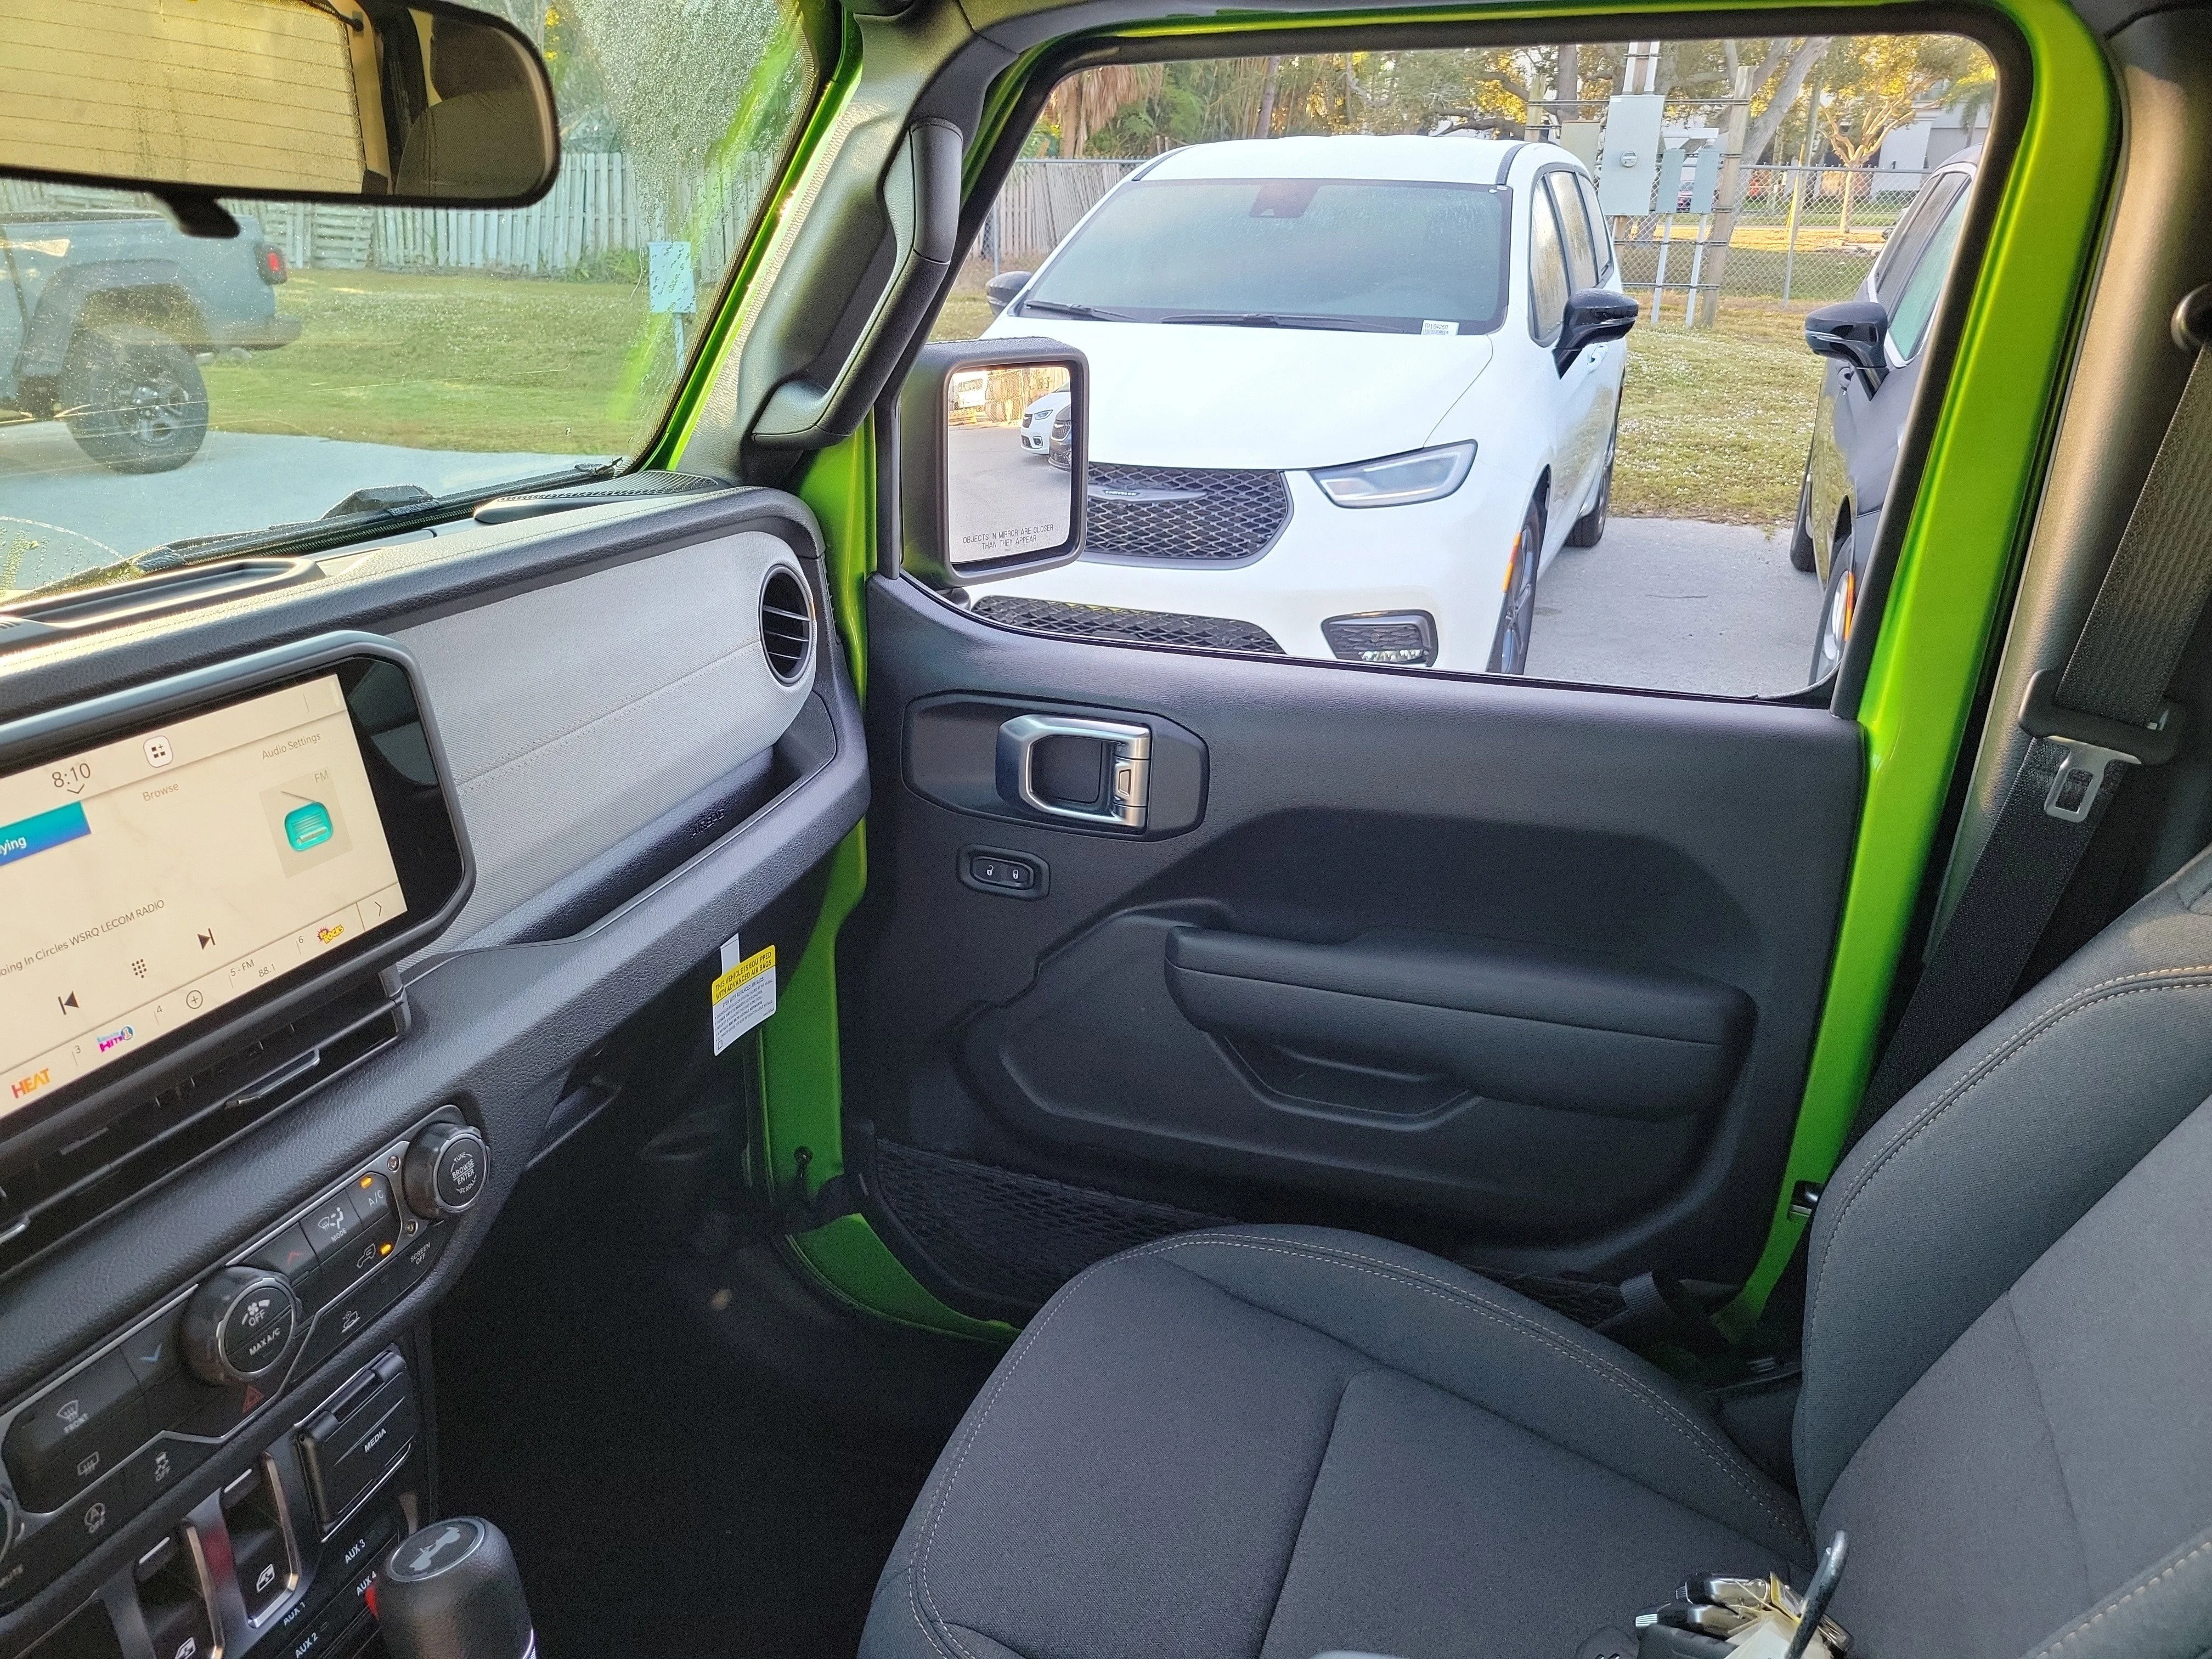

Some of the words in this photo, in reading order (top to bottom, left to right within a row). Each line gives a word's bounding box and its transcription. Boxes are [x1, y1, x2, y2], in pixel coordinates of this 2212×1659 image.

[963, 533, 989, 544] OBJECTS
[998, 529, 1019, 539] MIRROR
[1020, 527, 1031, 535] ARE
[1033, 524, 1054, 533] CLOSER
[982, 540, 997, 550] THAN
[1000, 539, 1013, 548] THEY
[1015, 534, 1037, 545] APPEAR
[262, 744, 287, 760] Audio
[287, 733, 321, 750] Settings
[52, 763, 91, 788] 8:10
[314, 770, 329, 783] FM
[143, 782, 179, 802] Browse
[0, 836, 27, 856] ying
[24, 956, 34, 966] In
[35, 941, 69, 961] Circles
[69, 927, 99, 946] WSRQ
[100, 911, 136, 933] LECOM
[136, 899, 165, 918] RADIO
[298, 935, 304, 944] 6
[230, 968, 236, 977] 5
[241, 959, 255, 971] FM
[258, 963, 275, 977] 88.1
[715, 980, 725, 992] THIS
[725, 967, 743, 984] VEHICLE
[744, 964, 748, 972] IS
[749, 951, 772, 969] EQUIPPED
[716, 988, 726, 1001] WITH
[727, 972, 751, 992] ADVANCED
[759, 959, 772, 972] BAGS
[756, 977, 764, 985] BAGS
[156, 1005, 162, 1013] 4
[75, 1045, 81, 1054] 3
[11, 1068, 50, 1098] HEAT
[454, 1152, 466, 1163] TUNE
[452, 1158, 475, 1178] BROWSE
[457, 1168, 475, 1185] ENTER
[459, 1180, 476, 1194] SCROLL
[368, 1189, 384, 1207] A/C
[331, 1227, 347, 1242] MODE
[410, 1242, 431, 1262] SCREEN
[415, 1253, 426, 1265] OFF
[249, 1309, 265, 1326] OFF
[249, 1338, 267, 1356] MAX
[267, 1328, 280, 1344] A/C
[64, 1413, 89, 1434] FRONT
[364, 1428, 387, 1453] MEDIA
[155, 1465, 172, 1481] OFF
[88, 1517, 106, 1534] OFF
[345, 1543, 361, 1564] AUX
[359, 1538, 366, 1548] 3
[357, 1575, 373, 1596] AUX
[371, 1570, 377, 1579] 4
[283, 1607, 301, 1626] AUX
[295, 1637, 313, 1659] AUX
[312, 1632, 318, 1641] 2
